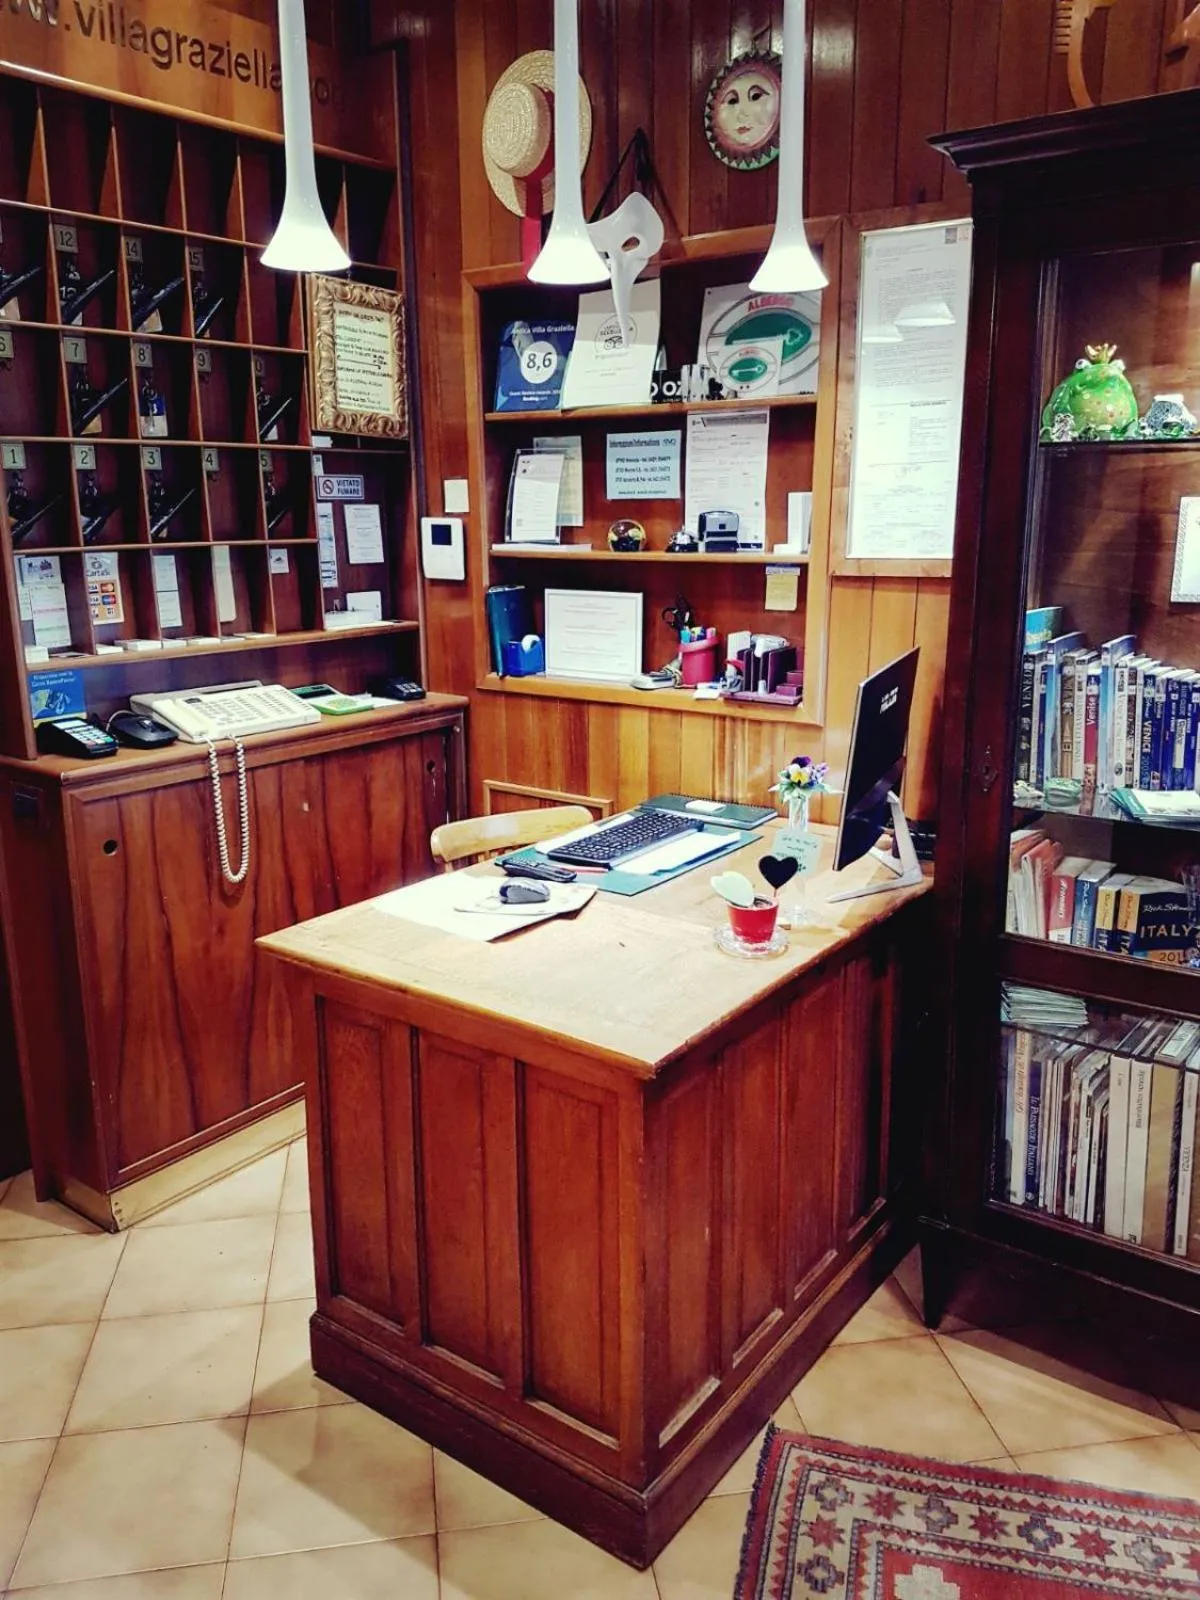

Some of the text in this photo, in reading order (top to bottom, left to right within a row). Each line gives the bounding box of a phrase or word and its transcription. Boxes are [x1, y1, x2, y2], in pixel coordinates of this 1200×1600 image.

[59, 230, 75, 248] 12
[125, 241, 139, 258] 14
[189, 250, 201, 264] 15
[71, 342, 80, 358] 7
[137, 347, 146, 362] 8
[197, 352, 206, 367] 9
[526, 351, 552, 372] 8,6
[11, 448, 17, 464] 1
[79, 450, 89, 465] 2
[146, 450, 156, 465] 3
[206, 452, 214, 467] 4
[260, 454, 269, 468] 5
[1142, 720, 1152, 753] VENICE
[1140, 924, 1193, 938] ITALY
